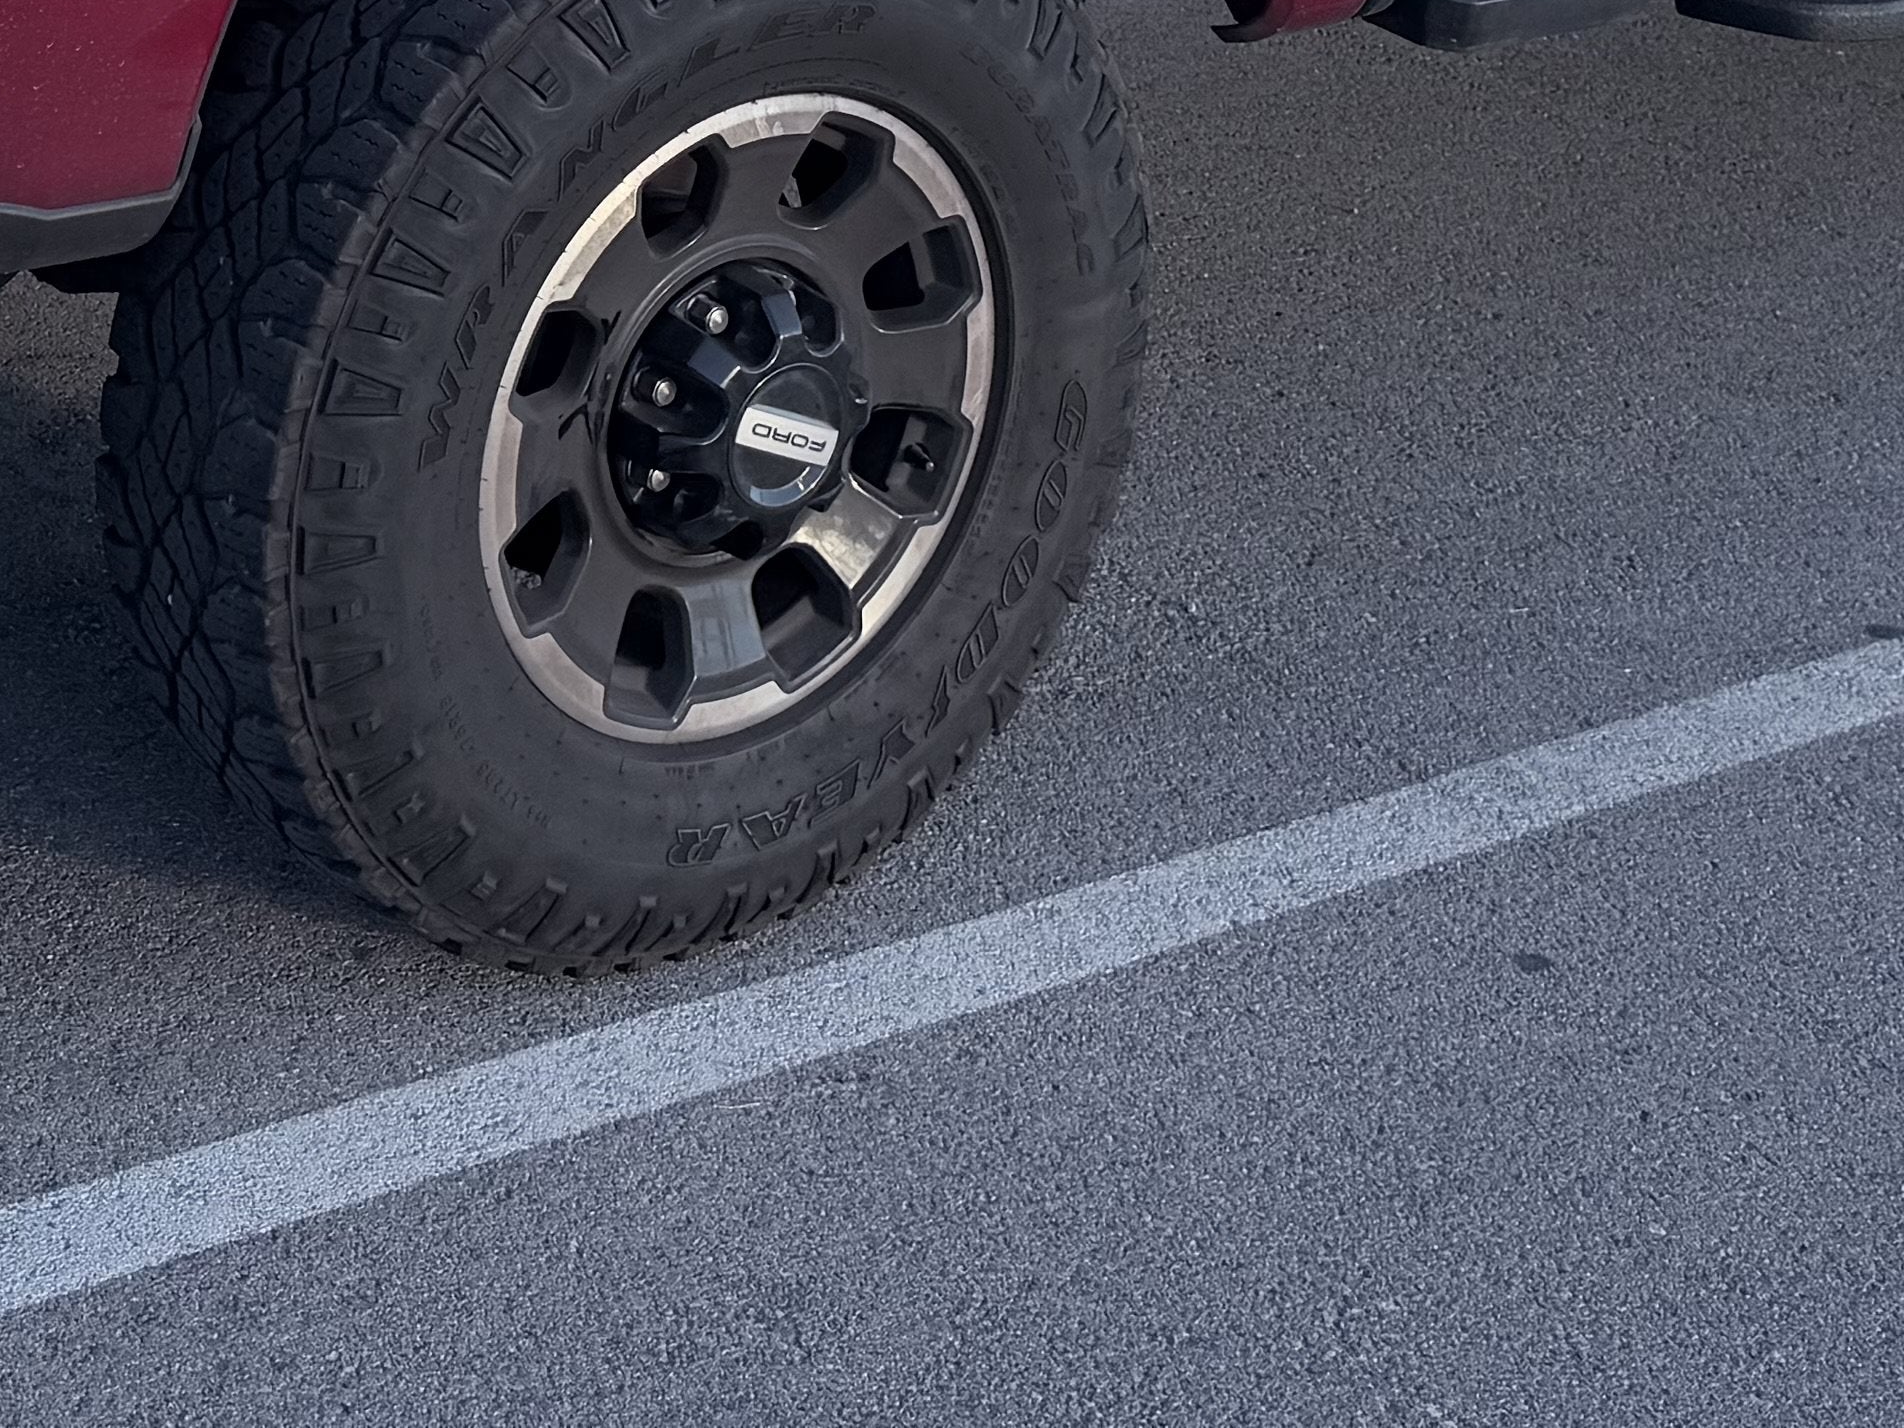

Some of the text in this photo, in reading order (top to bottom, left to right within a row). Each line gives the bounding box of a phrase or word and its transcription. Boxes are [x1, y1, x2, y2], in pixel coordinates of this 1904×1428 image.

[417, 2, 876, 474] WRANGLER
[752, 423, 827, 452] FORD
[668, 382, 1087, 867] GOODYEAR
